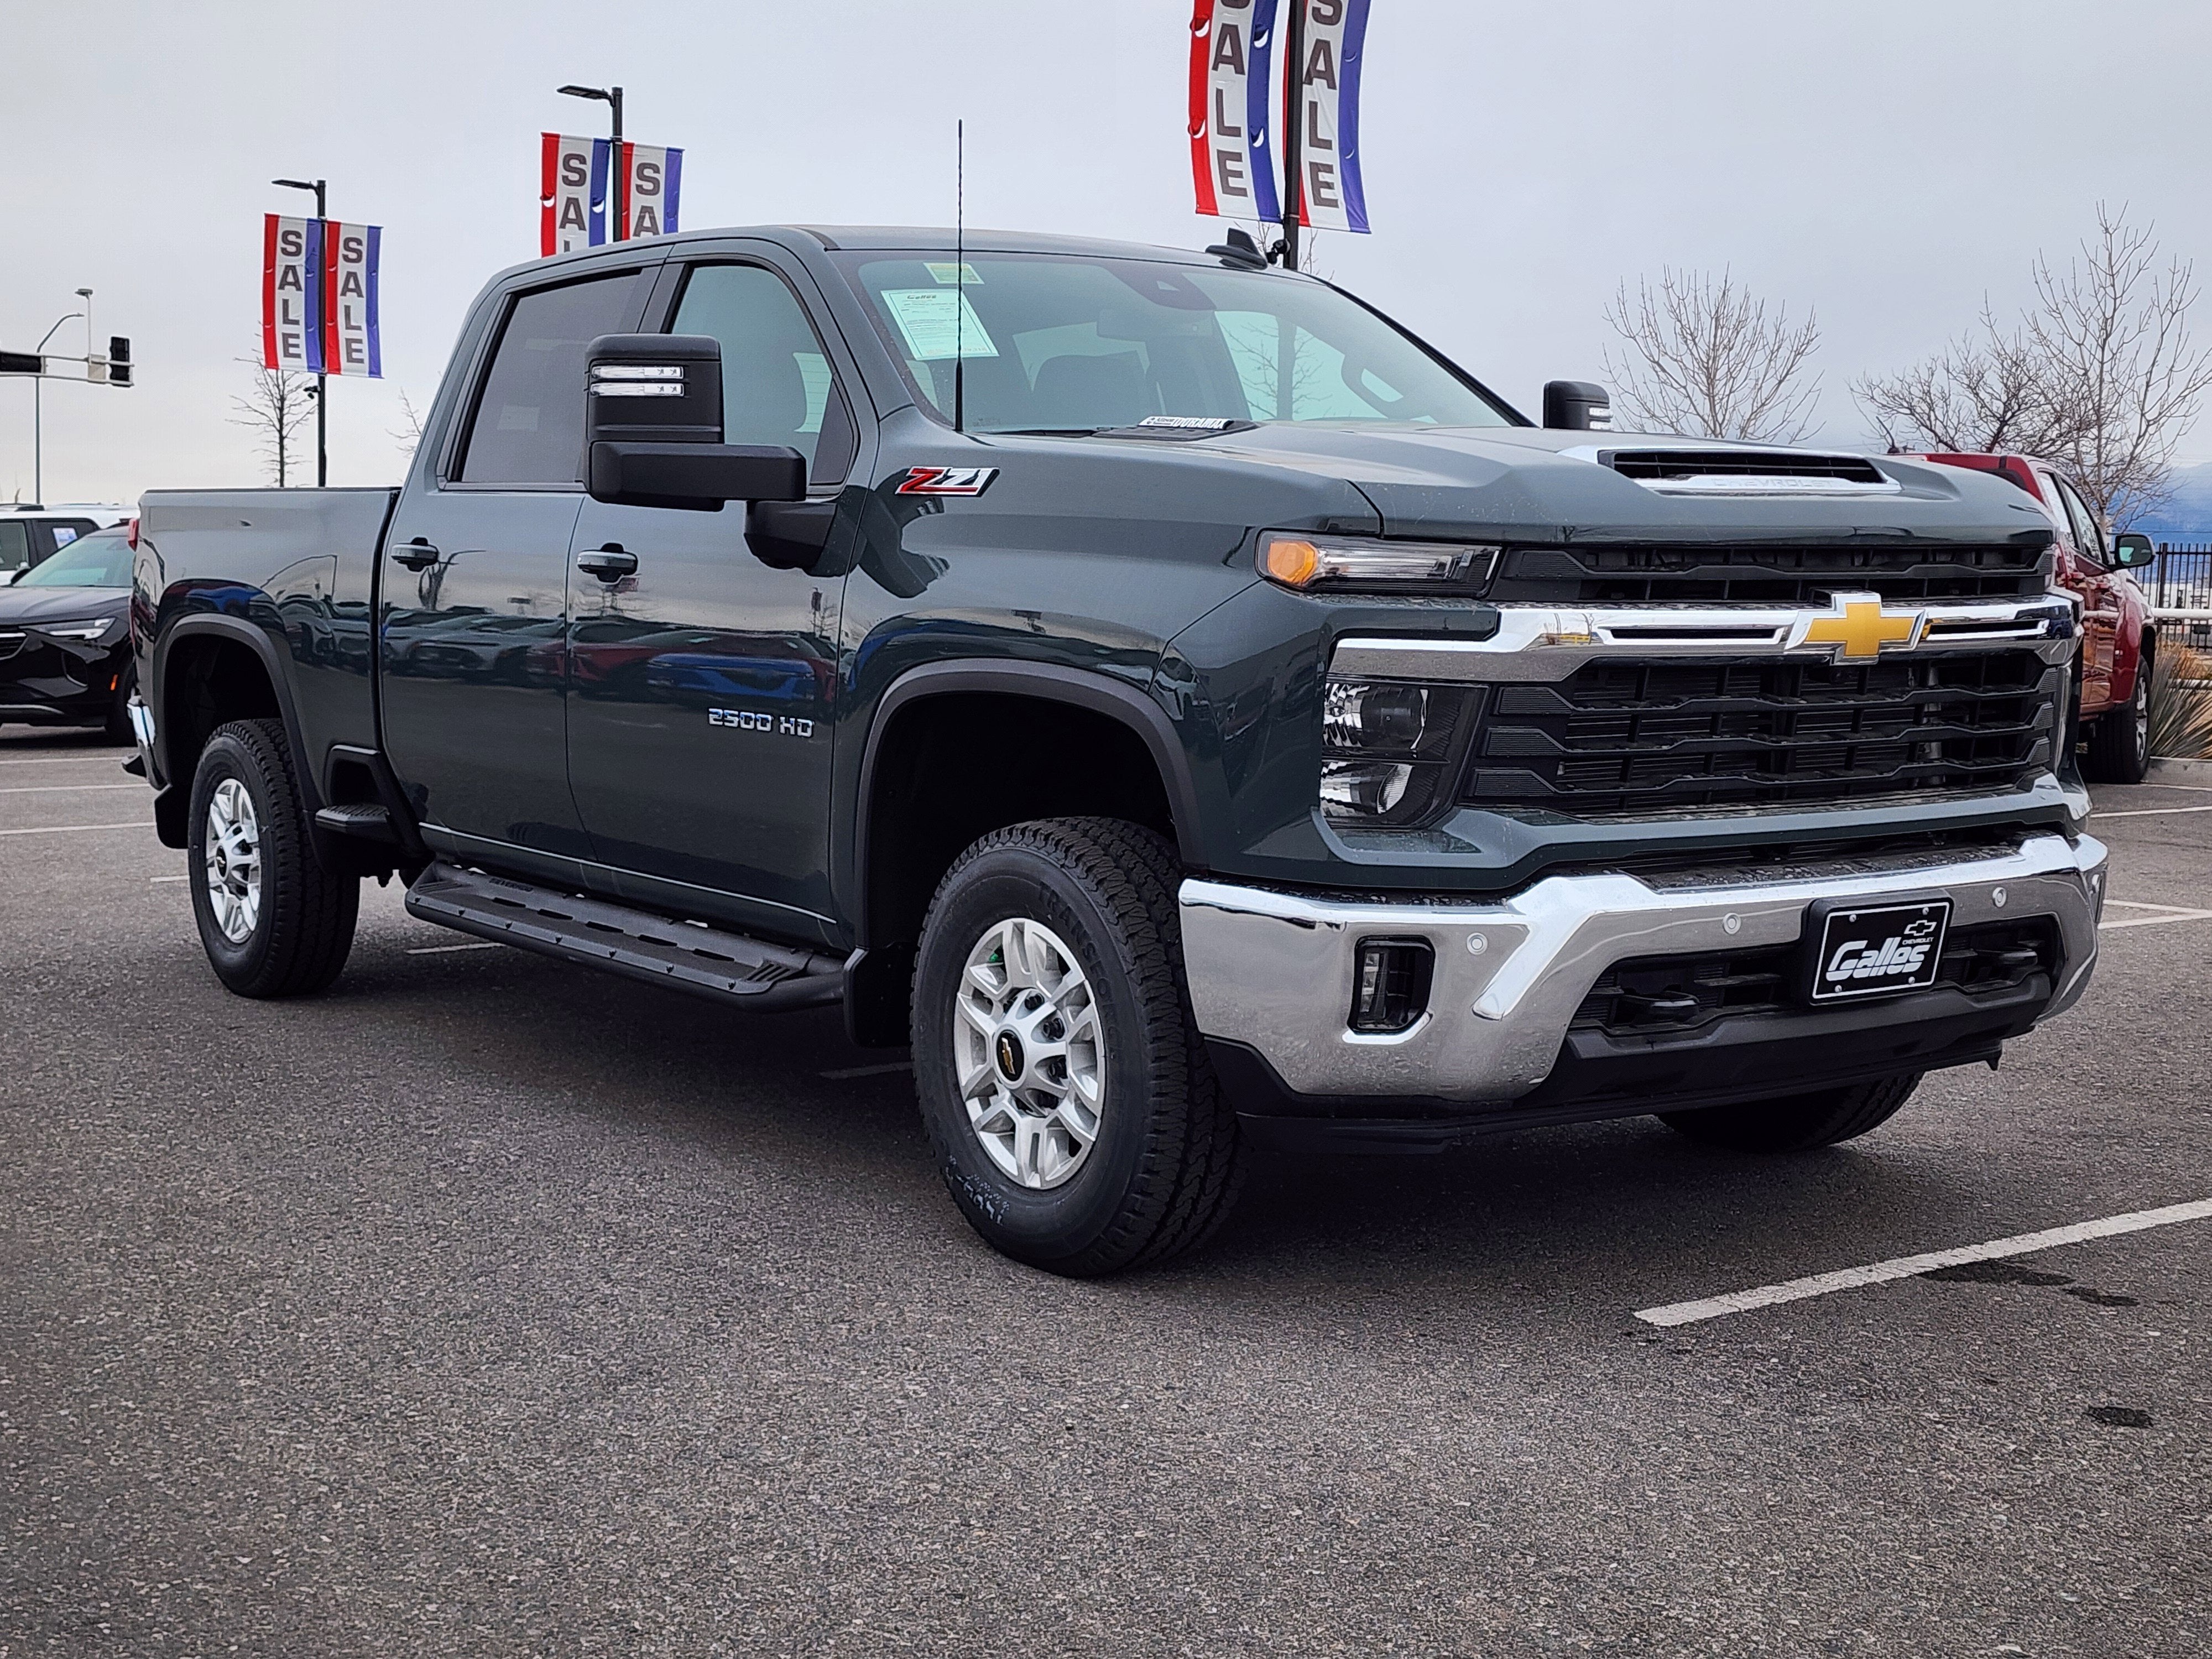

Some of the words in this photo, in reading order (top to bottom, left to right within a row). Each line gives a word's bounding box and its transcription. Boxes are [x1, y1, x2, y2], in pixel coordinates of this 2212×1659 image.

[1212, 0, 1248, 197] ALE
[277, 229, 302, 359] SALE
[340, 237, 364, 364] SALE
[896, 466, 999, 497] Z71
[708, 708, 773, 732] 2500
[779, 717, 814, 737] HD
